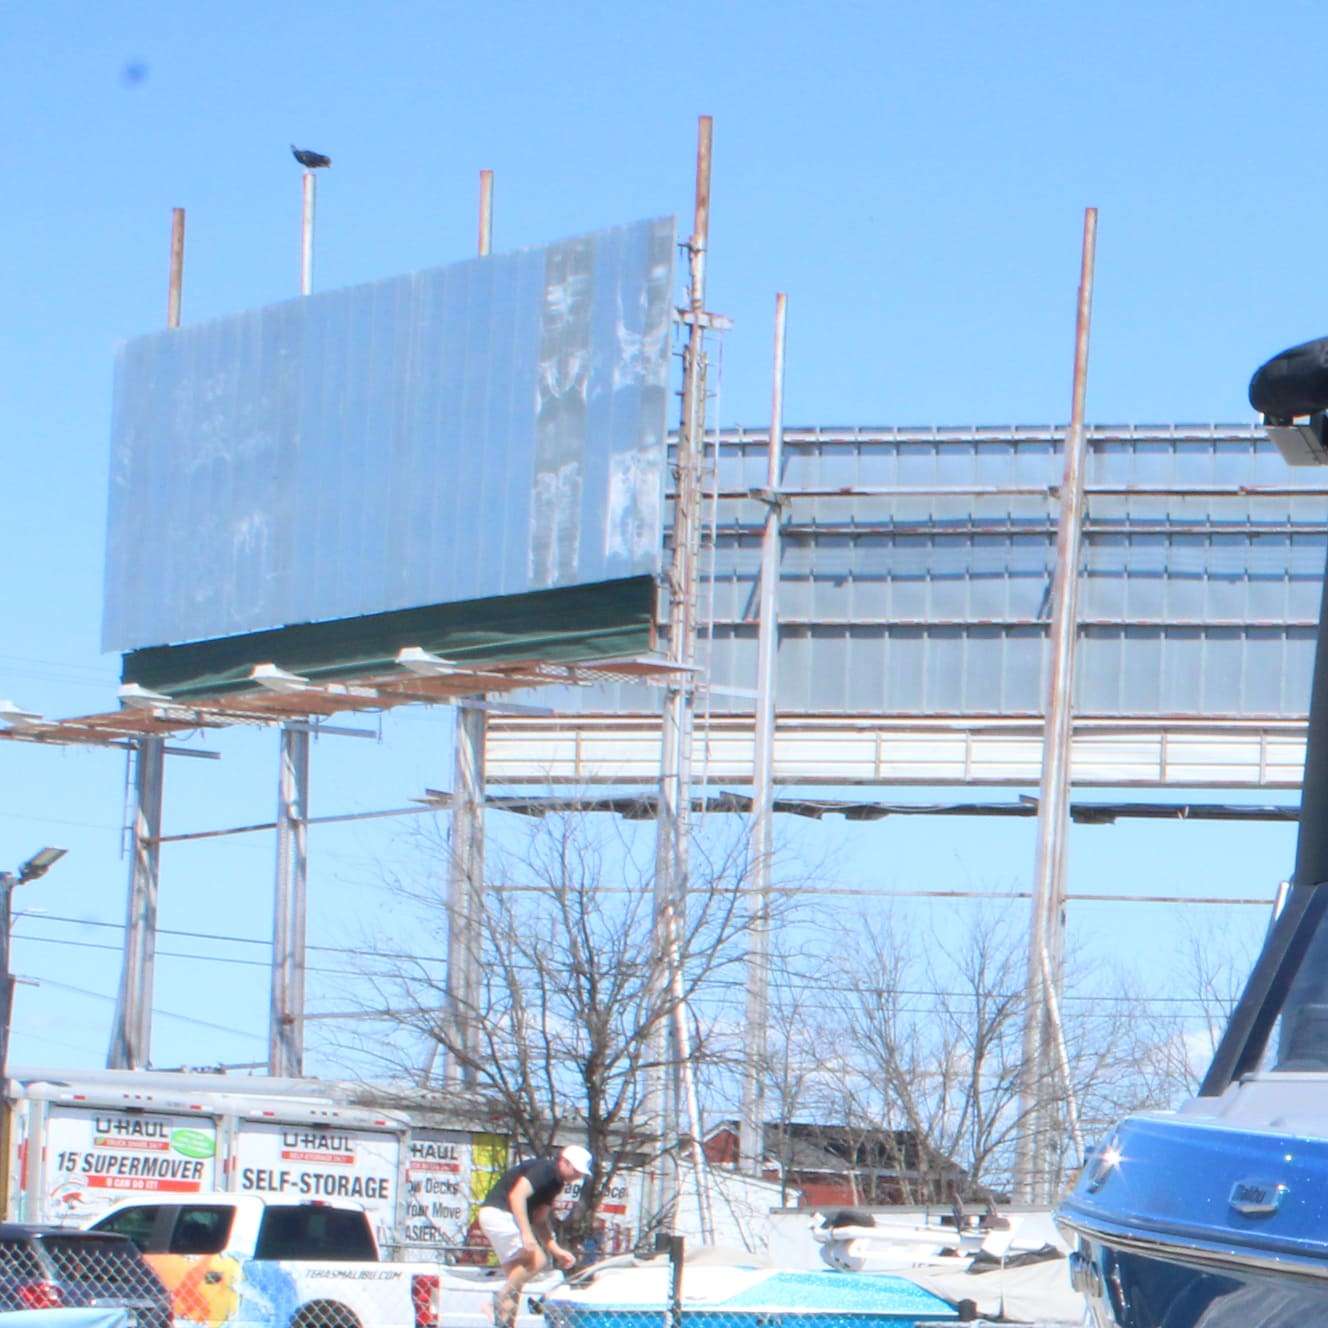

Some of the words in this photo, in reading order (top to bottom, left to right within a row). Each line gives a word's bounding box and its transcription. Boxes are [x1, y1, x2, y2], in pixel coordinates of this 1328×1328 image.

[96, 1117, 169, 1138] U-HAUL
[283, 1133, 354, 1152] U-HAUL
[82, 1153, 205, 1180] SUPERMOVER
[242, 1168, 390, 1199] SELF-STORAGE
